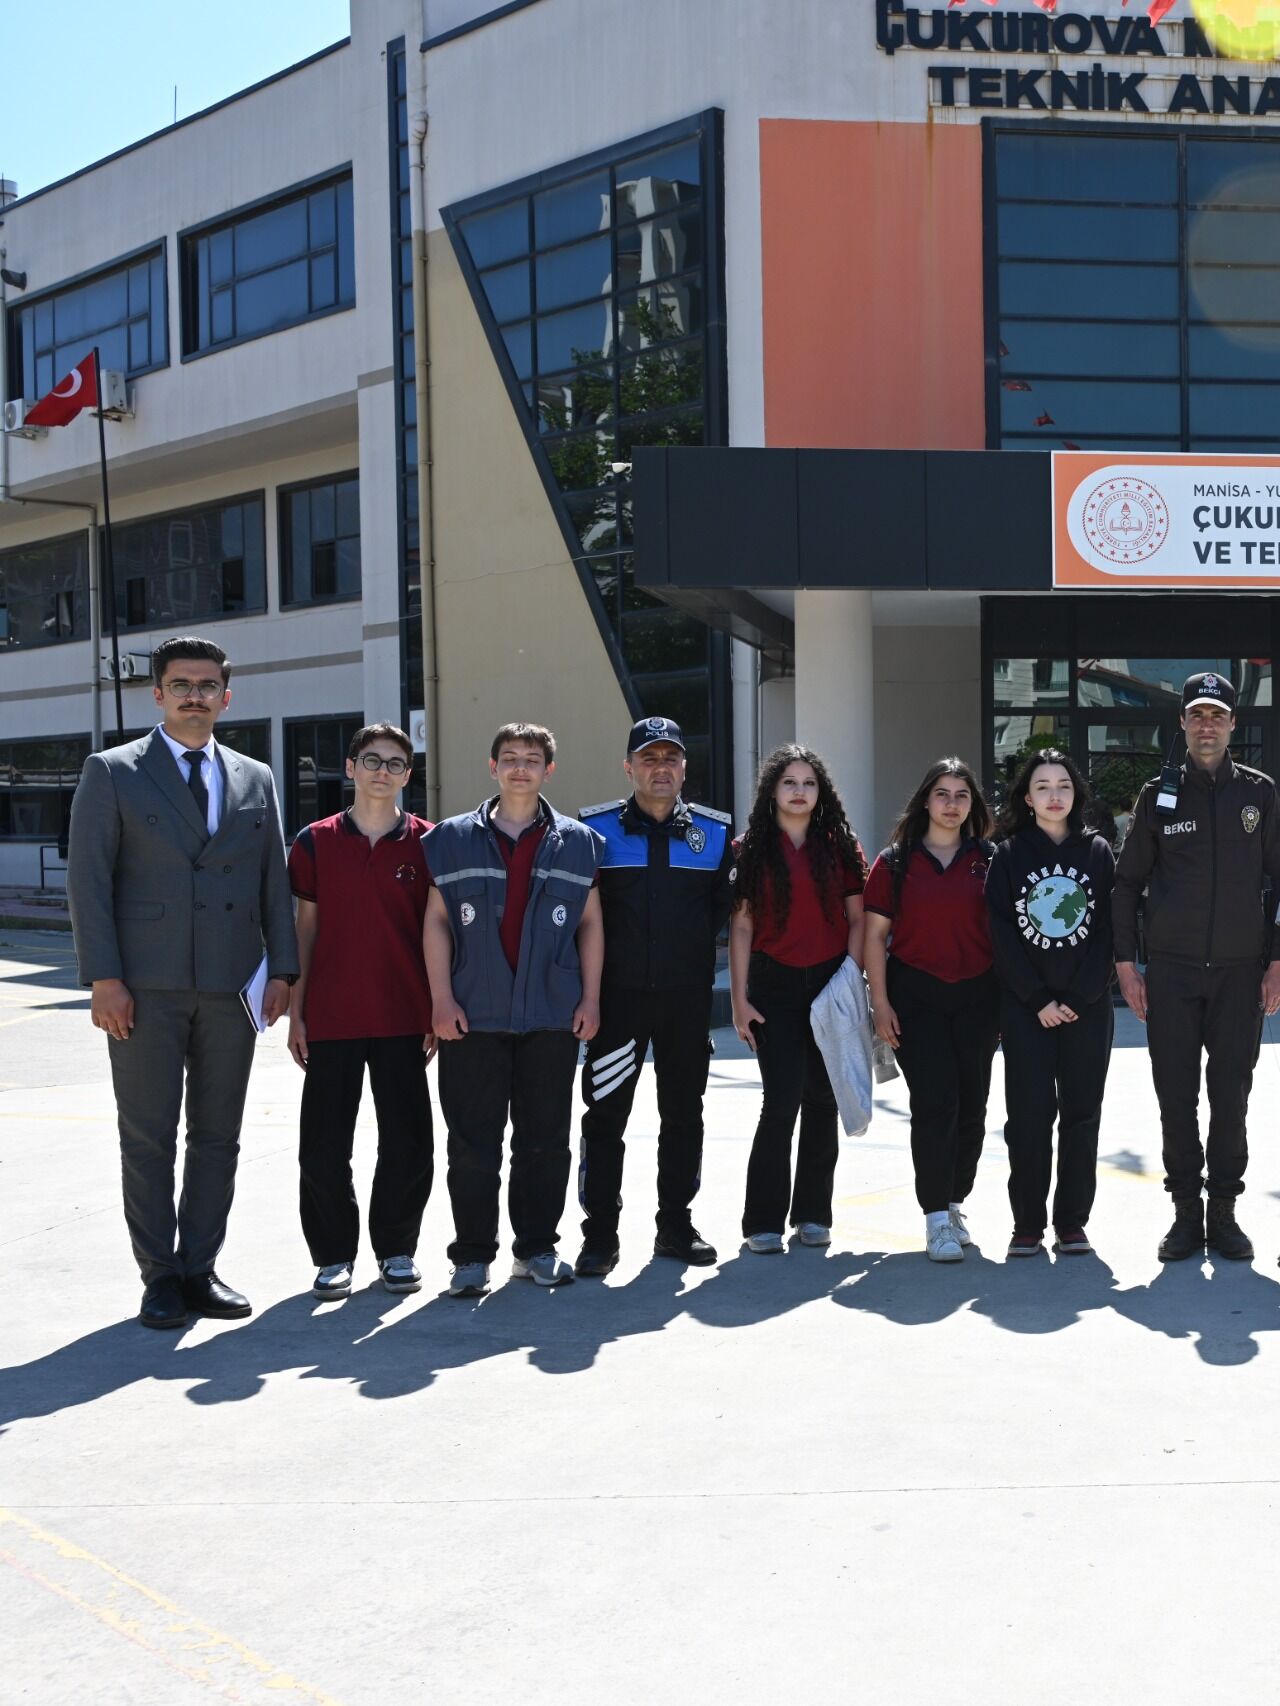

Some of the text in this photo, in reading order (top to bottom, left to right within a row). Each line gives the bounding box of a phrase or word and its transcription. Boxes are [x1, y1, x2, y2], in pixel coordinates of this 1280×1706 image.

[876, 0, 1167, 56] ÇUKUROVA
[928, 63, 1150, 112] TEKNİK
[1193, 482, 1251, 497] MANİSA
[1193, 541, 1232, 564] VE
[1163, 820, 1197, 835] BEKÇİ
[1026, 863, 1090, 884] HEART
[1015, 898, 1051, 949] WORLD
